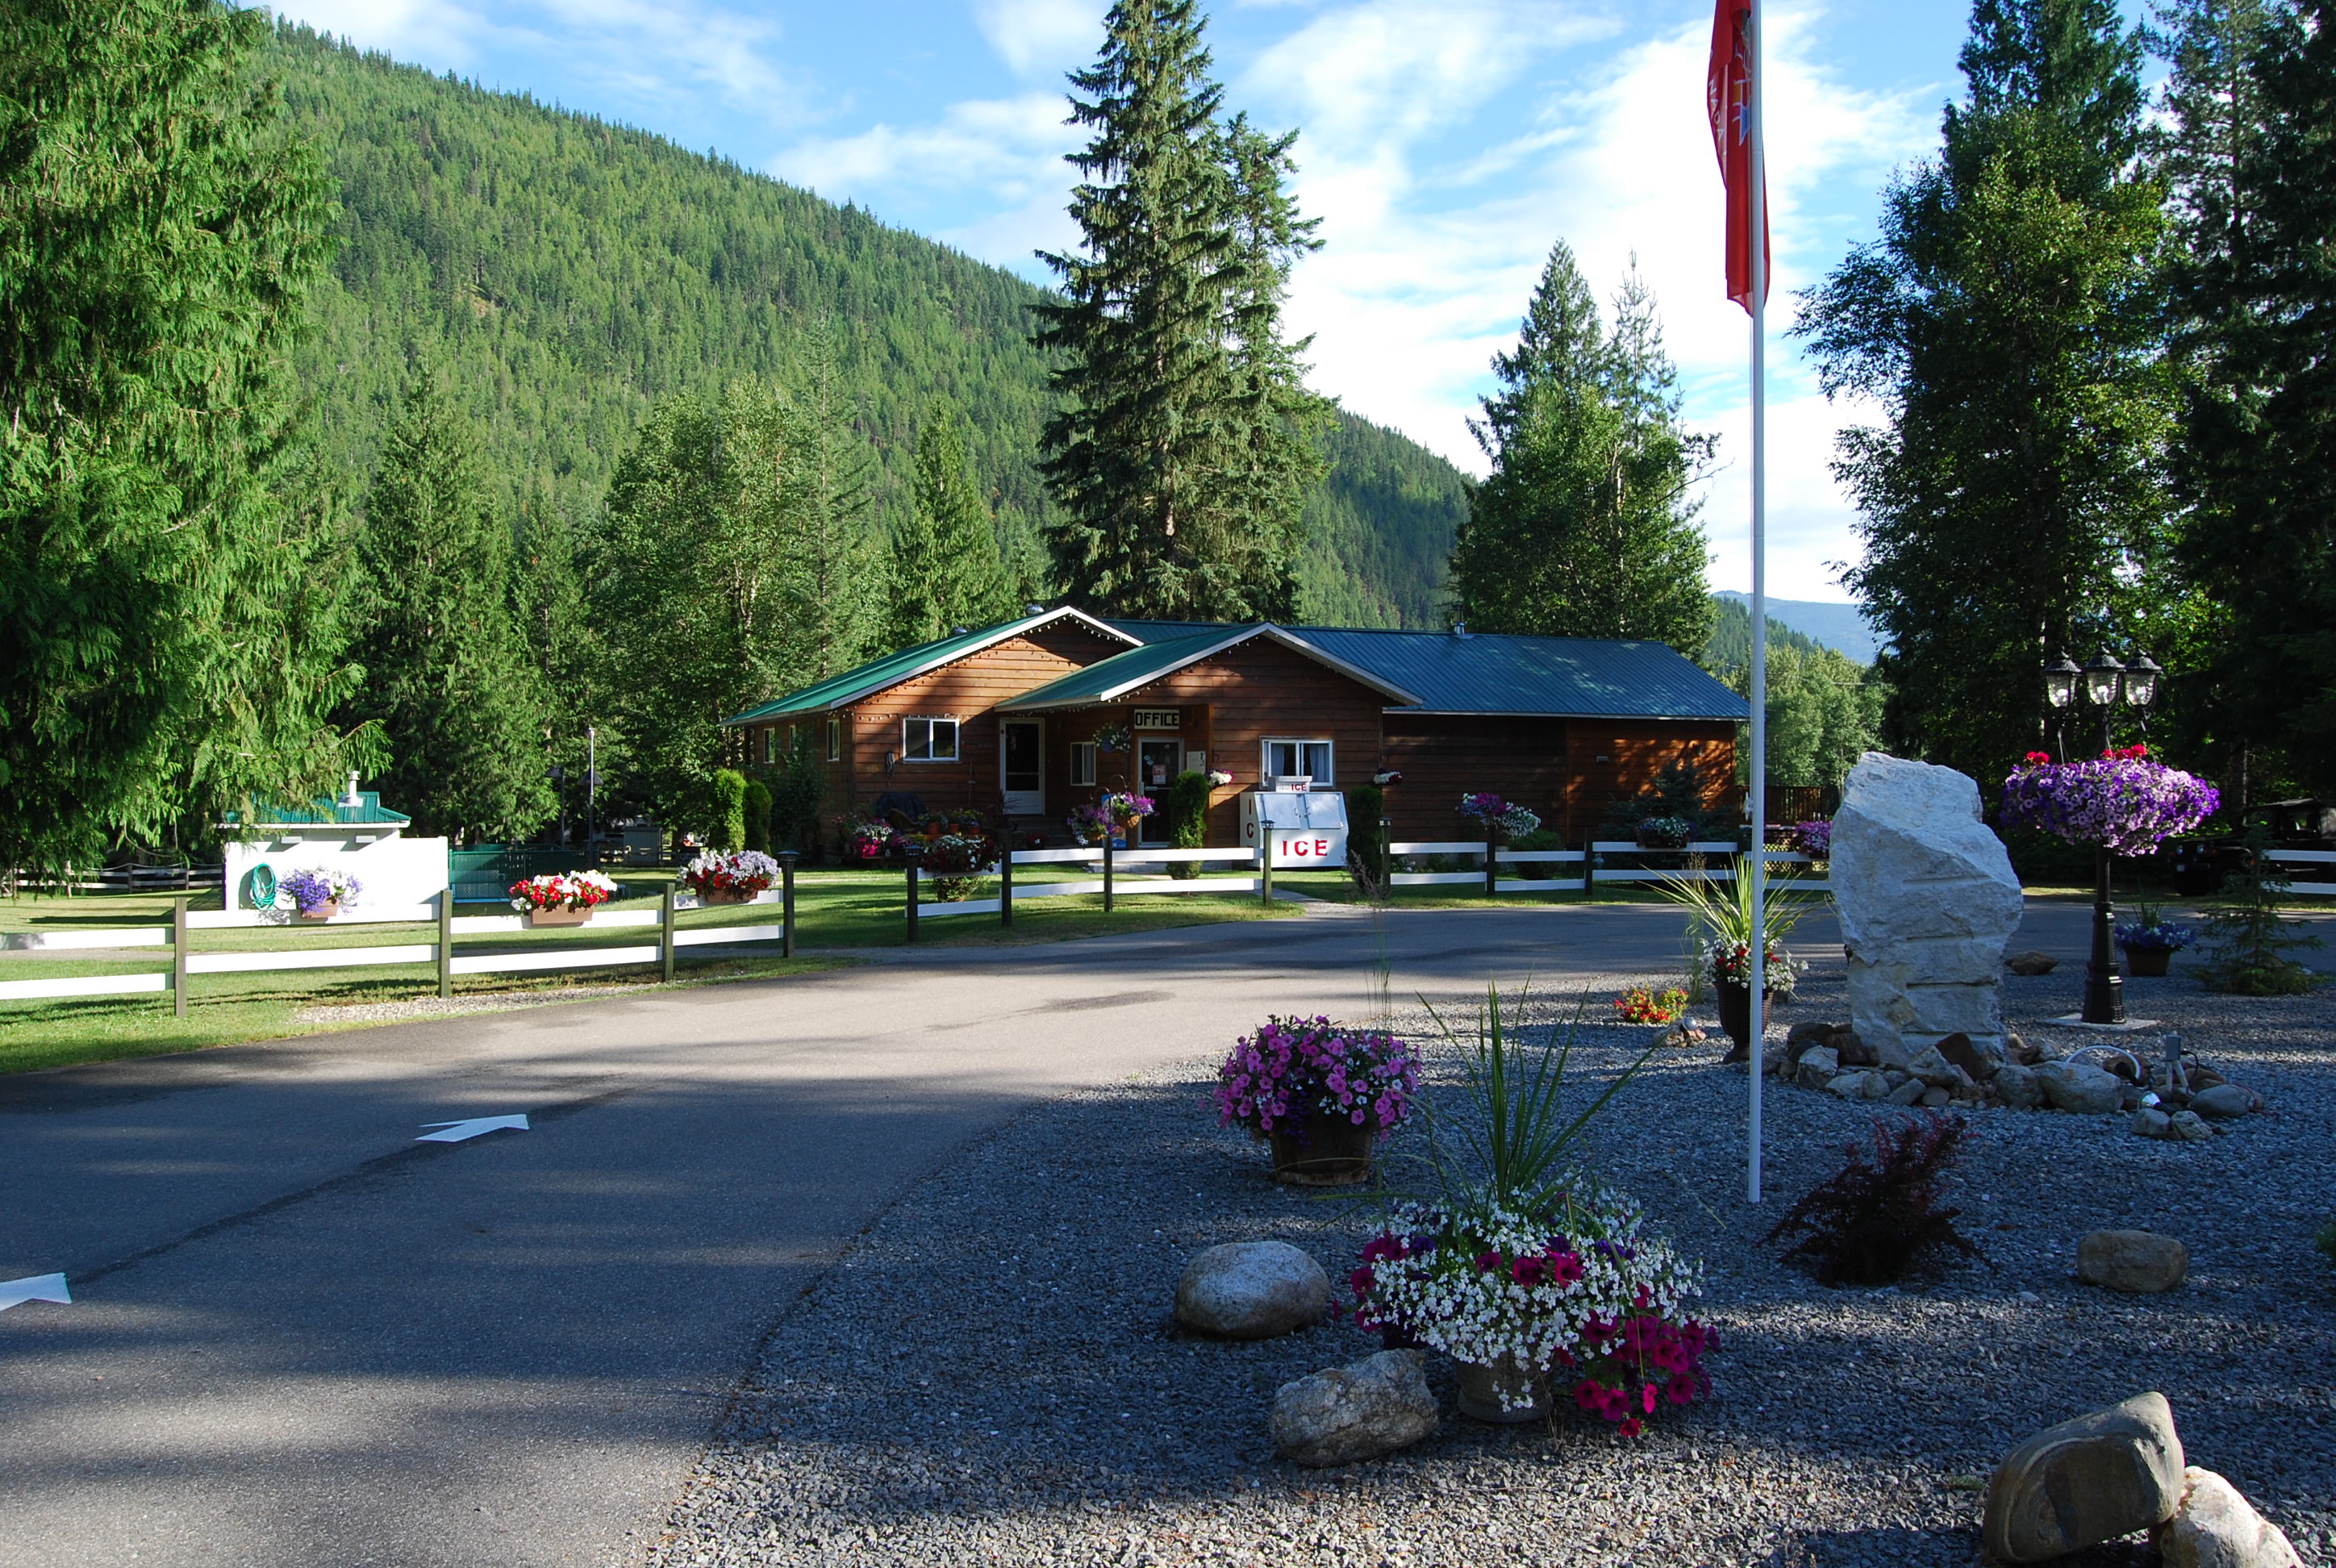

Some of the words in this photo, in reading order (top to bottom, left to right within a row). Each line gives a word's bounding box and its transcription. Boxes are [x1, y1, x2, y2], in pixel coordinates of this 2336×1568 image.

[1708, 78, 1725, 141] NADA
[1135, 712, 1178, 726] OFFICE
[1246, 799, 1254, 848] IC
[1283, 839, 1328, 856] ICE
